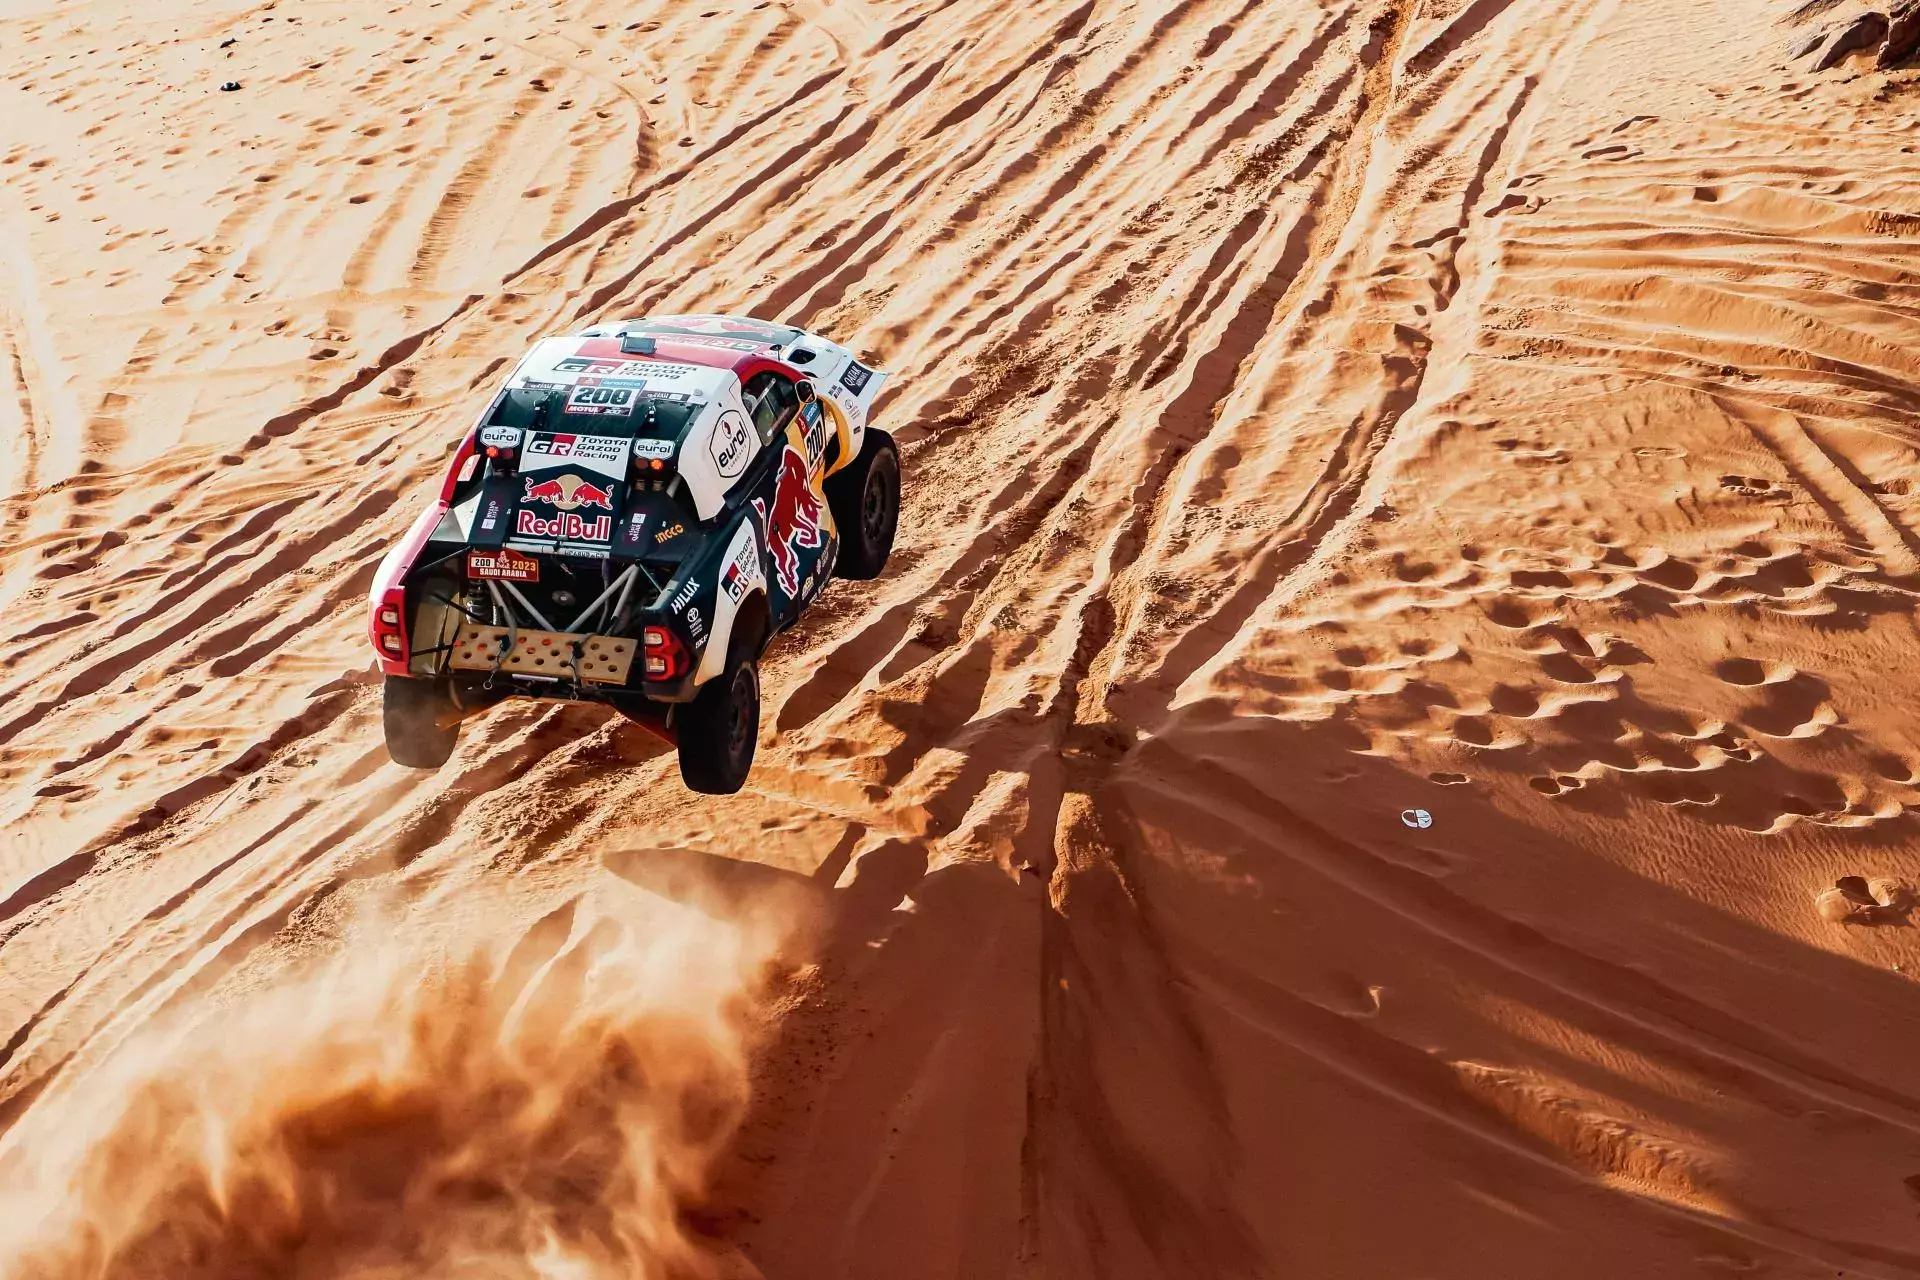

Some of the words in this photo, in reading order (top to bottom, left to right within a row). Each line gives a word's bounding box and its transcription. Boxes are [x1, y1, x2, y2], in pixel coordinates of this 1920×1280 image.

[552, 361, 617, 375] GR
[630, 362, 698, 372] TOYOTA
[844, 365, 862, 386] QATAR
[574, 387, 632, 405] 200
[568, 404, 600, 414] MOTUL
[484, 432, 518, 442] eurol
[580, 436, 628, 447] TOYOTA
[528, 440, 574, 456] GR
[576, 443, 621, 453] GAZOO
[637, 442, 672, 454] eurol
[718, 421, 747, 468] eurol
[806, 420, 824, 468] 200
[573, 450, 618, 462] Racing
[516, 509, 566, 537] Red
[565, 513, 612, 542] Bull
[735, 535, 752, 564] TOYOTA
[475, 558, 491, 567] 200
[512, 560, 536, 571] 2023
[480, 568, 501, 576] SAUDI
[501, 570, 527, 578] ARABIA
[670, 576, 700, 615] HILUX
